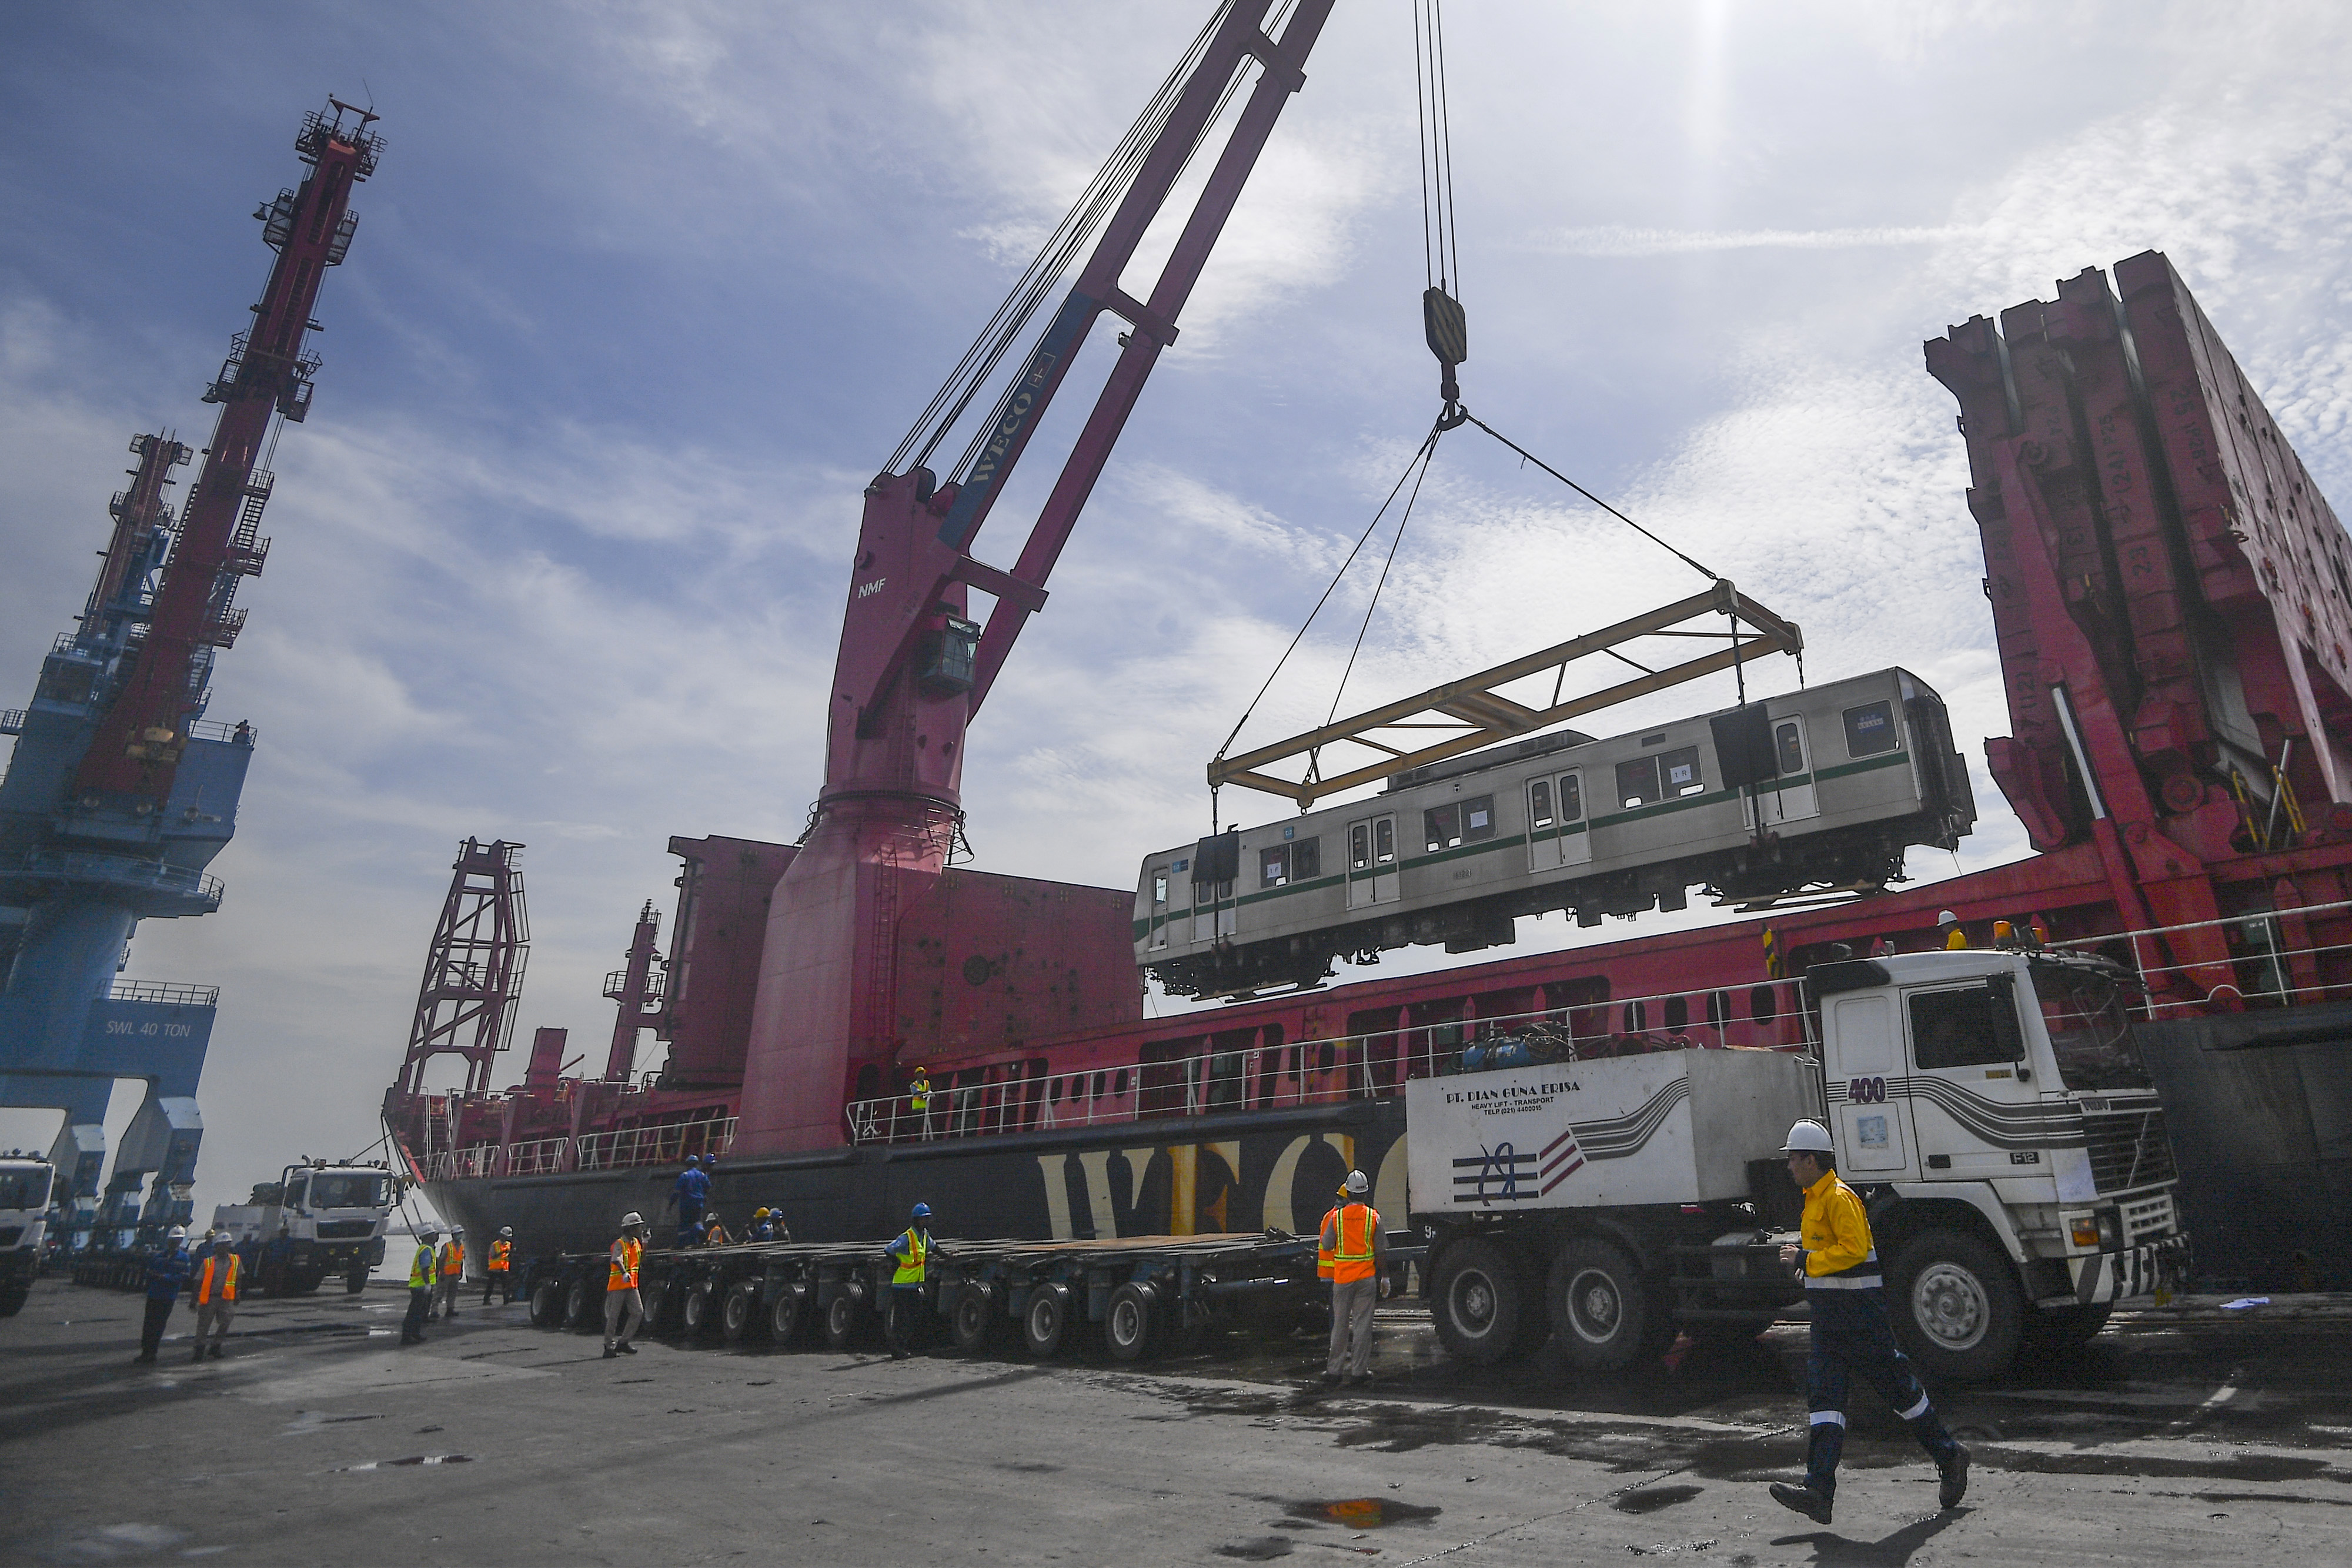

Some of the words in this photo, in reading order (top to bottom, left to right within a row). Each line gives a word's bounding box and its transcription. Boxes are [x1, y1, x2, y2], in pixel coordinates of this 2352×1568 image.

[972, 392, 1031, 482] WECO
[2128, 546, 2151, 577] 23
[858, 577, 886, 599] NMF
[106, 1021, 133, 1035] SWL
[141, 1023, 158, 1035] 40
[164, 1024, 191, 1037] TON
[1446, 1093, 1464, 1104] PT.
[1468, 1089, 1498, 1102] DIAN
[1502, 1086, 1538, 1098] GUNA
[1541, 1081, 1580, 1094] ERISA
[1514, 1096, 1553, 1105] TRANSPORT
[1849, 1076, 1886, 1103] 400
[2013, 1152, 2035, 1164] F12
